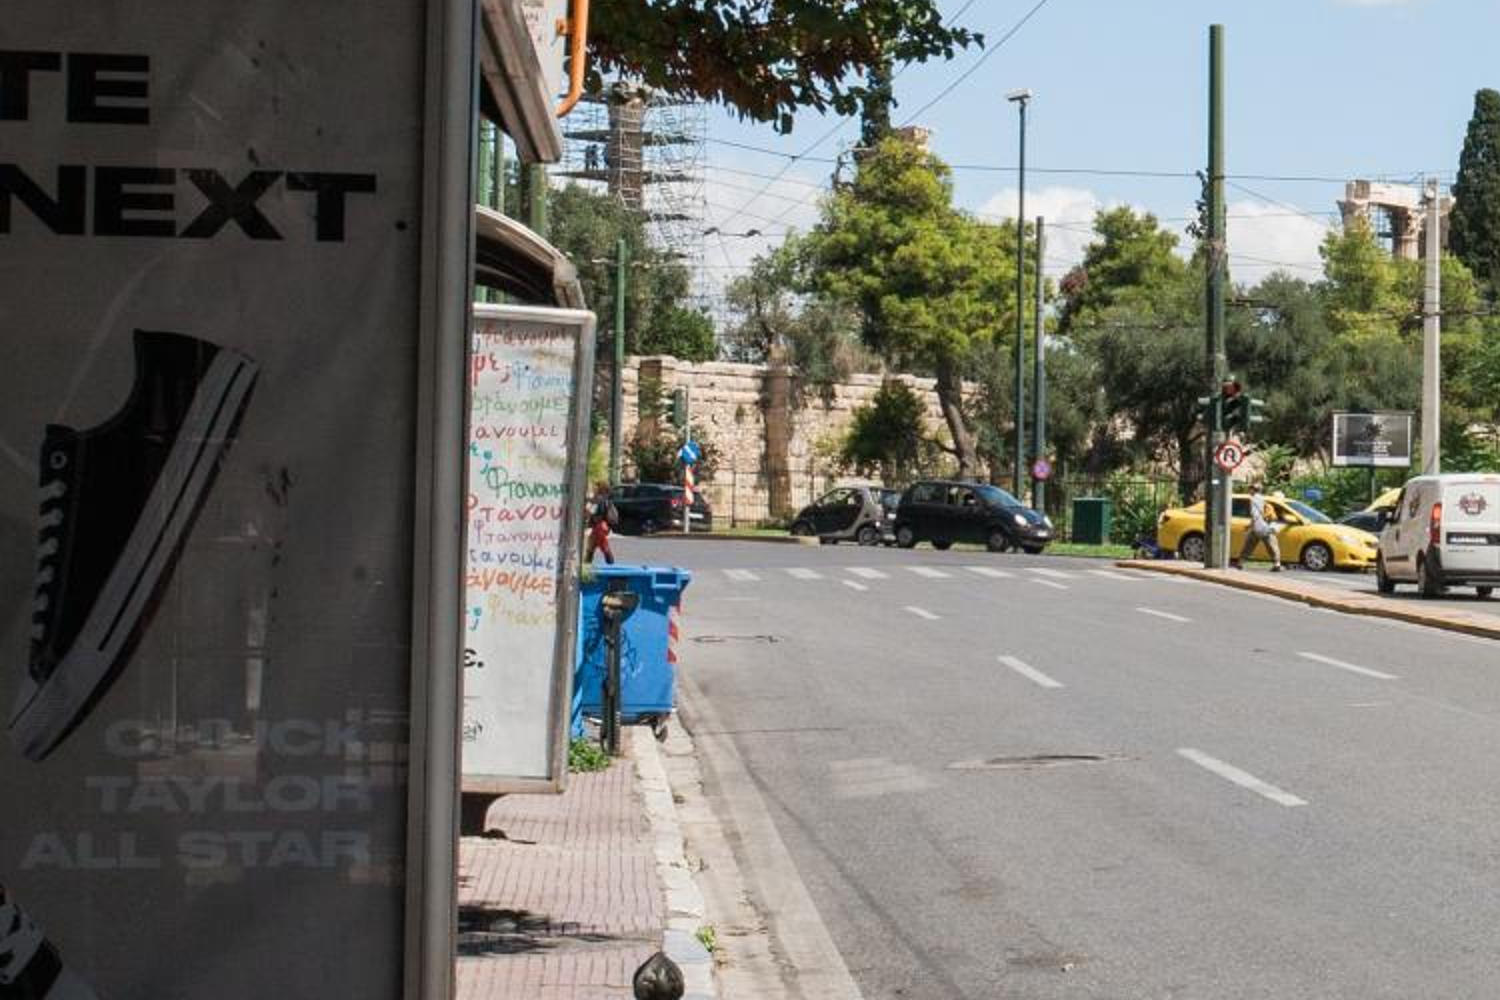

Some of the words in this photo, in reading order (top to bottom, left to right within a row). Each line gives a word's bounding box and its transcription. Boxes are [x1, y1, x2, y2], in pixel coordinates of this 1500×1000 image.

[0, 51, 150, 125] TE
[0, 163, 376, 242] NEXT
[86, 776, 375, 813] TAYLOR
[20, 832, 161, 868] ALL
[177, 831, 372, 869] STAR
